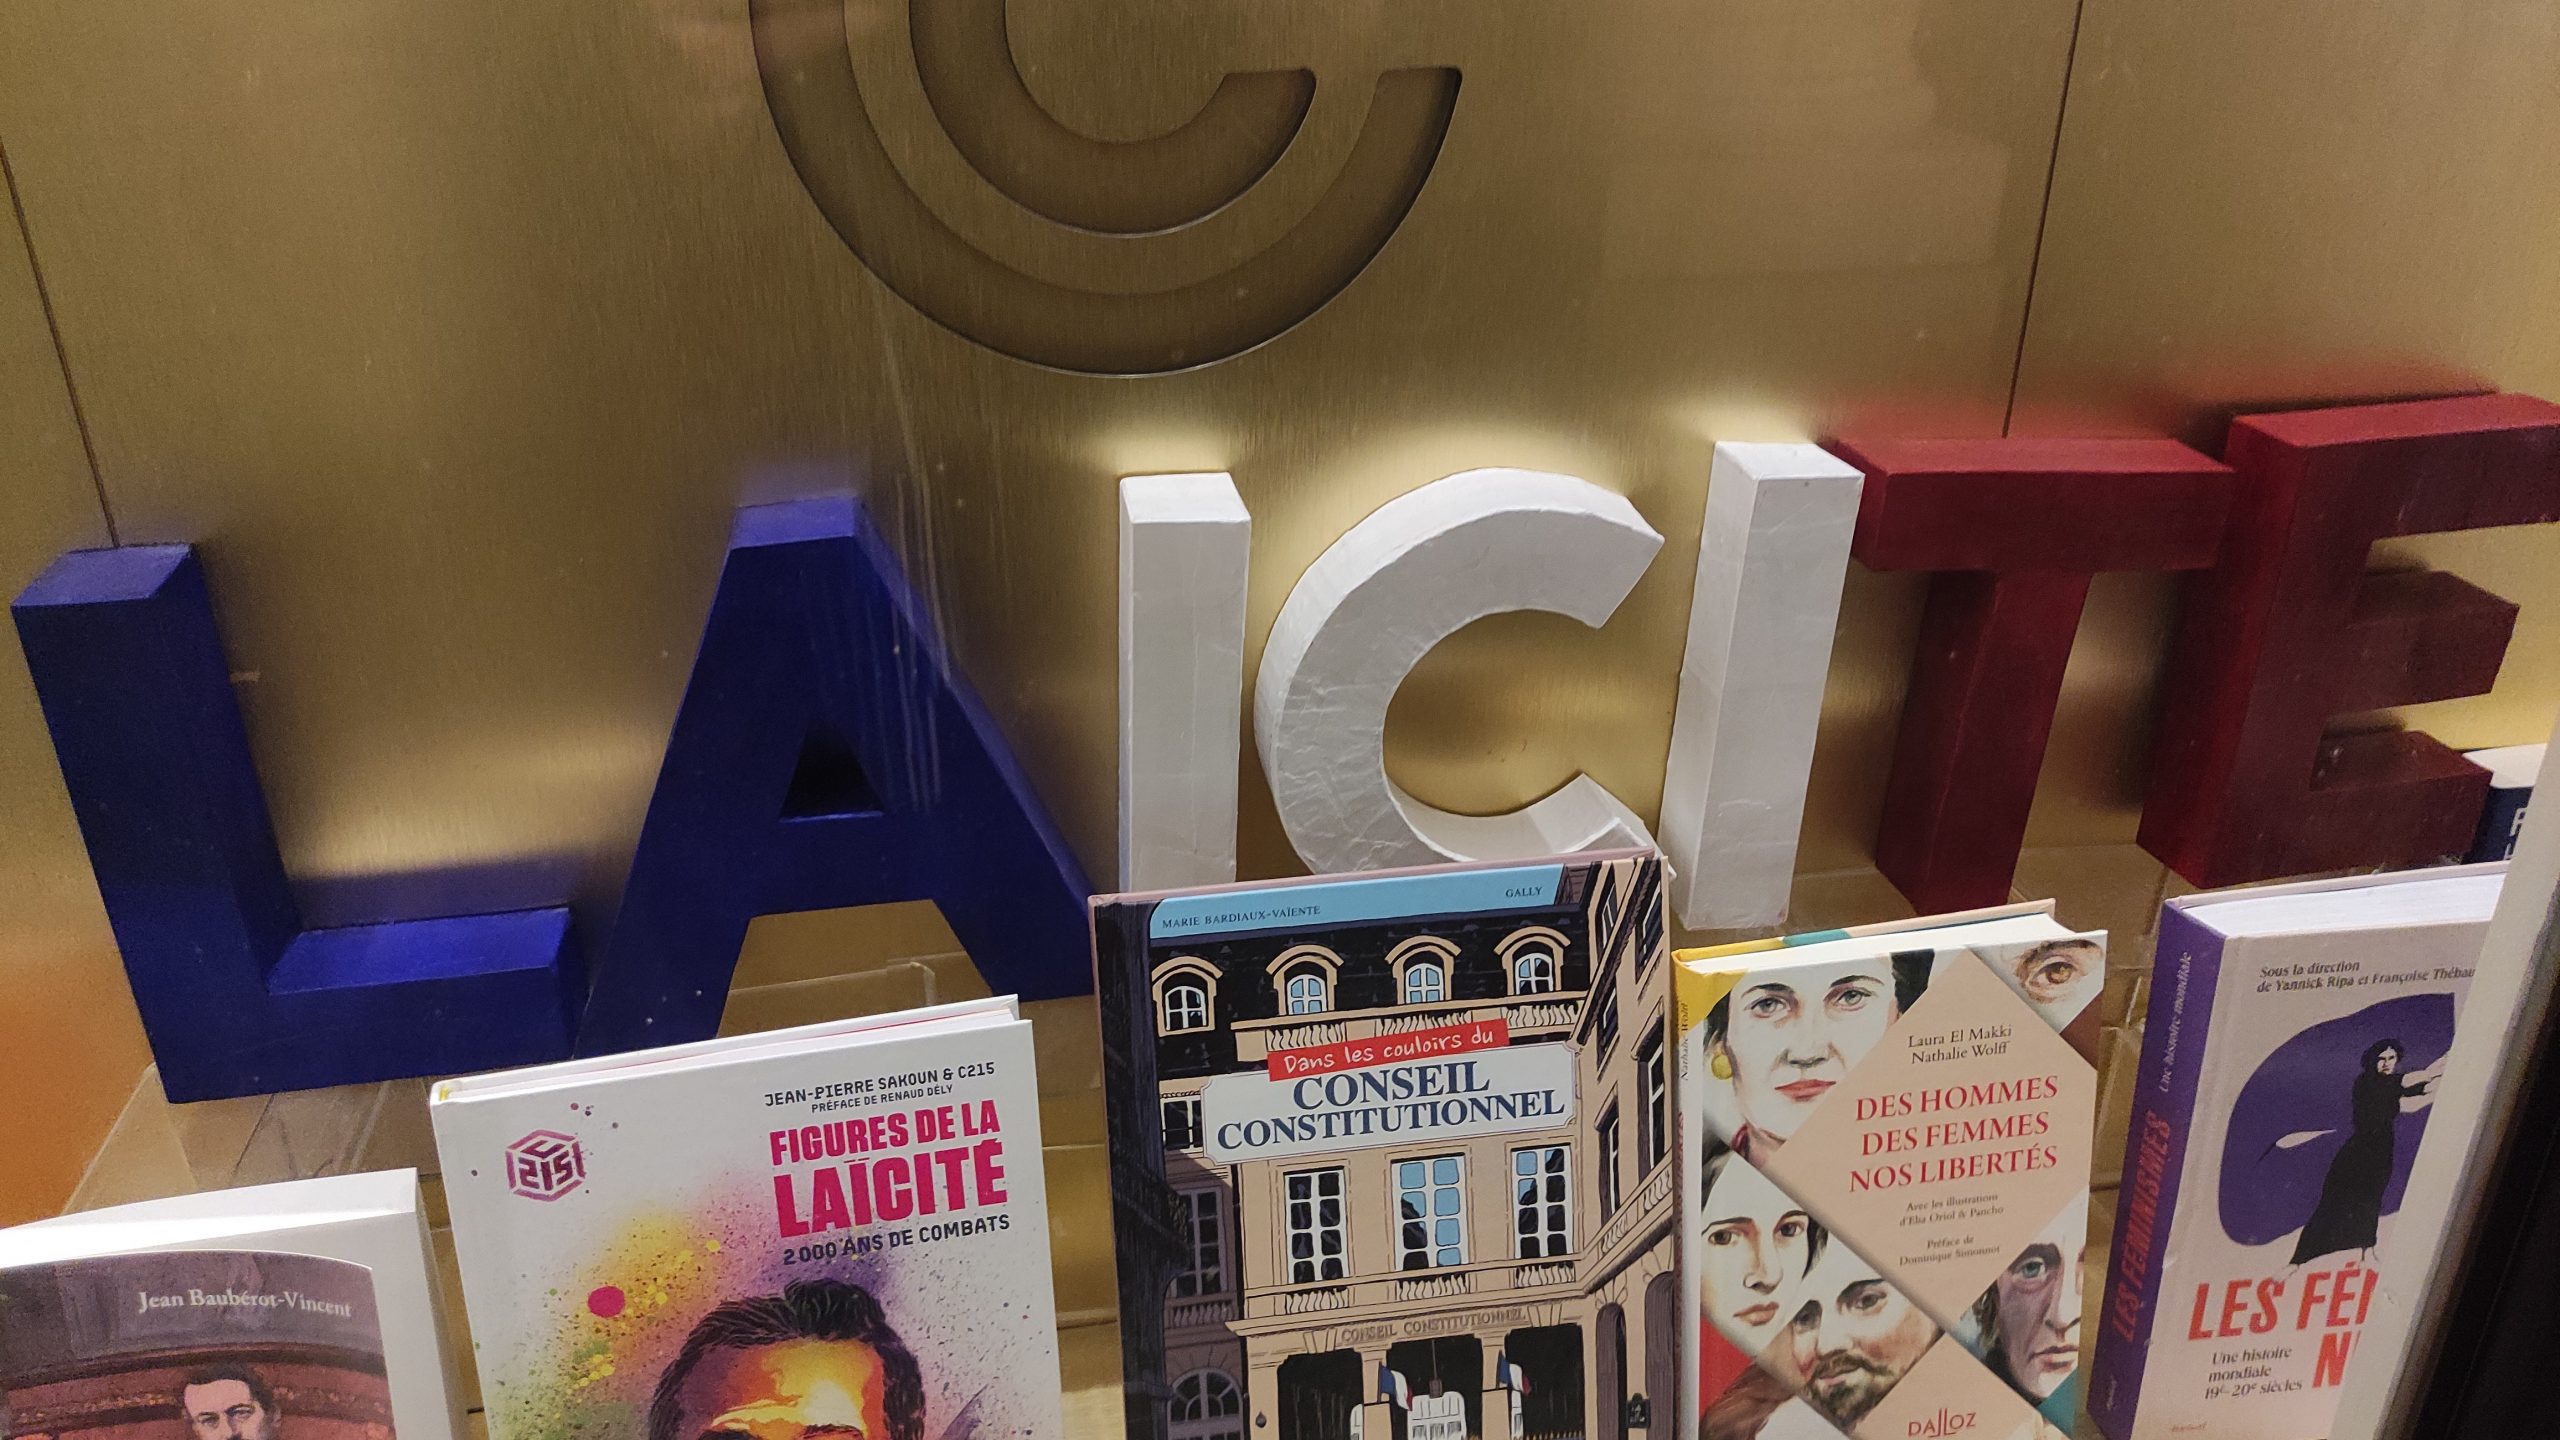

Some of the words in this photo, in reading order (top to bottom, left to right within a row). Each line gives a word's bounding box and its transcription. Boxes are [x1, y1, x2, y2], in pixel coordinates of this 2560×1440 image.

[10, 390, 2560, 1105] LAICITE
[1505, 886, 1543, 898] GALLY
[1162, 916, 1200, 929] MARIE
[1205, 905, 1321, 925] BARDIAUX-VAÏENTE
[2256, 981, 2272, 993] de
[2275, 976, 2323, 991] Yannick
[2326, 975, 2355, 989] Ripa
[2358, 975, 2369, 986] et
[2372, 970, 2429, 984] Françoise
[2259, 964, 2289, 978] Sous
[2293, 963, 2304, 976] la
[2307, 961, 2361, 975] direction
[1283, 1051, 1335, 1074] Dans
[1344, 1045, 1374, 1064] les
[1383, 1033, 1463, 1058] couloirs
[1471, 1025, 1494, 1045] du
[1908, 1035, 1945, 1048] Laura
[1950, 1029, 1964, 1043] El
[1969, 1024, 2012, 1042] Makki
[1911, 1046, 1968, 1064] Nathalie
[1972, 1041, 2011, 1057] Wolff
[764, 1079, 874, 1107] JEAN-PIERRE
[878, 1069, 938, 1091] SAKOUN
[943, 1067, 954, 1081] &
[957, 1061, 995, 1079] C215
[1293, 1060, 1490, 1111] CONSEIL
[2159, 1067, 2173, 1092] Une
[811, 1098, 861, 1114] PRÉFACE
[863, 1095, 878, 1107] DE
[881, 1089, 925, 1104] RENAUD
[926, 1083, 954, 1097] DÉLY
[1855, 1091, 1913, 1122] DES
[1919, 1075, 2058, 1113] HOMMES
[769, 1111, 909, 1167] FIGURES
[914, 1105, 956, 1144] DE
[961, 1098, 1001, 1137] LA
[1217, 1089, 1566, 1151] CONSTITUTIONNEL
[1862, 1127, 1918, 1156] DES
[1925, 1111, 2049, 1149] FEMMES
[1849, 1162, 1913, 1193] NOS
[1919, 1142, 2058, 1185] LIBERTÉS
[773, 1137, 1008, 1239] LAÏCITÉ
[1907, 1202, 1929, 1213] Avec
[1931, 1200, 1944, 1209] les
[1946, 1194, 1999, 1207] illustrations
[1970, 1205, 2005, 1218] Pancho
[841, 1234, 884, 1256] ANS
[889, 1229, 913, 1248] DE
[919, 1214, 1011, 1242] COMBATS
[1926, 1238, 1961, 1250] Préface
[1963, 1235, 1975, 1245] de
[1899, 1252, 1953, 1267] Dominique
[138, 1291, 185, 1314] Jean
[188, 1288, 353, 1318] Baubérot-Vincent
[2110, 1281, 2140, 1344] LES
[2188, 1277, 2286, 1342] LES
[1341, 1324, 1398, 1343] CONSEIL
[1403, 1306, 1527, 1336] CONSTITUTIONNEL
[2212, 1352, 2240, 1366] Une
[2242, 1345, 2293, 1362] histoire
[2208, 1365, 2273, 1383] mondiale
[2259, 1379, 2304, 1394] siècles
